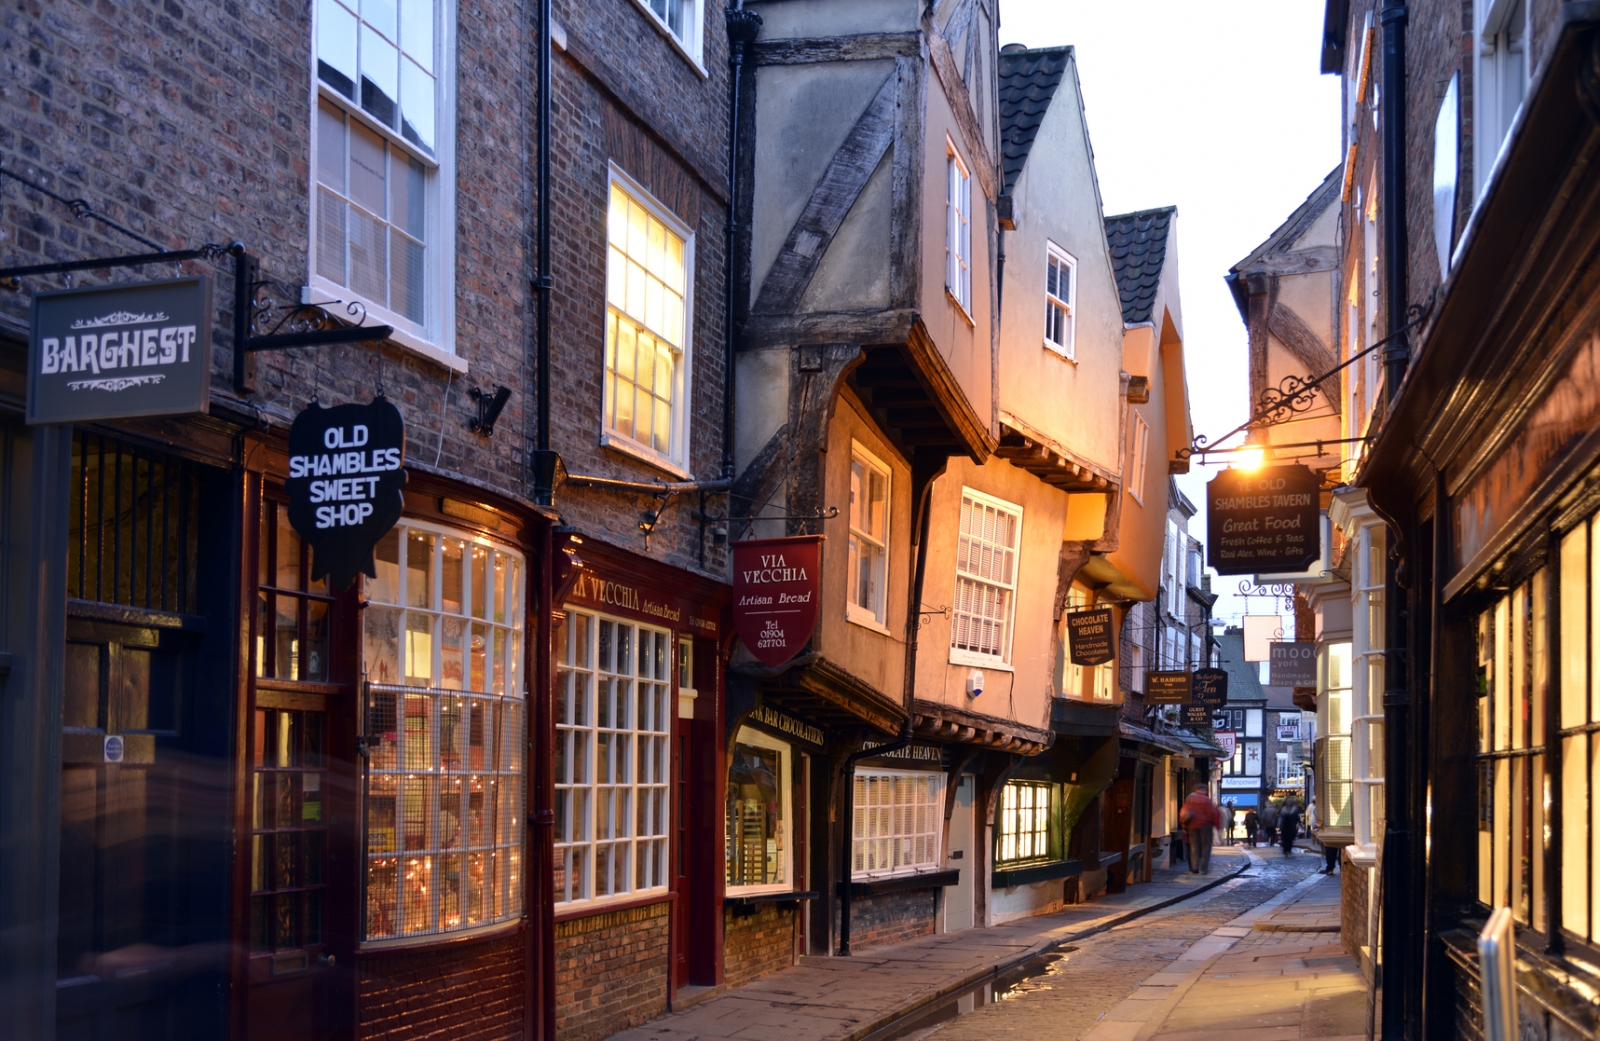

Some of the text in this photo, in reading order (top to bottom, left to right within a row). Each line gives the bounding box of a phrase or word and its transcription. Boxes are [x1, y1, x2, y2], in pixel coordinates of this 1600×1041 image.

[41, 325, 196, 375] BARGHEST
[323, 424, 369, 450] OLD
[289, 448, 401, 479] SHAMBLES
[309, 476, 380, 503] SWEET
[1258, 478, 1286, 491] OLD
[1215, 493, 1311, 511] SHAMBLES TAVERN
[315, 502, 374, 529] SHOP
[1223, 514, 1301, 533] Great Food
[1220, 536, 1245, 546] Fresh
[1246, 535, 1272, 546] Coffee
[1285, 533, 1304, 543] Teas
[1257, 548, 1277, 557] Wine
[1285, 546, 1304, 556] Gifts
[761, 554, 786, 568] VIA
[743, 567, 808, 584] VECCHIA
[590, 577, 640, 611] VECCHIA
[642, 599, 664, 617] Artisan
[663, 604, 681, 622] Bread
[739, 590, 812, 606] Artisan Bread
[765, 620, 778, 630] Tel
[1071, 614, 1108, 626] CHOCOLATE
[760, 629, 784, 639] 01904
[1078, 625, 1103, 636] HEAVEN
[757, 638, 786, 649] 627701
[1075, 641, 1107, 649] Handmade
[1075, 649, 1108, 657] Chocolates
[1198, 679, 1217, 693] Tea
[764, 706, 779, 728] BAR
[778, 713, 825, 747] CHOCOLATIERS
[912, 745, 942, 761] HEAVEN
[1226, 778, 1258, 786] Manpower
